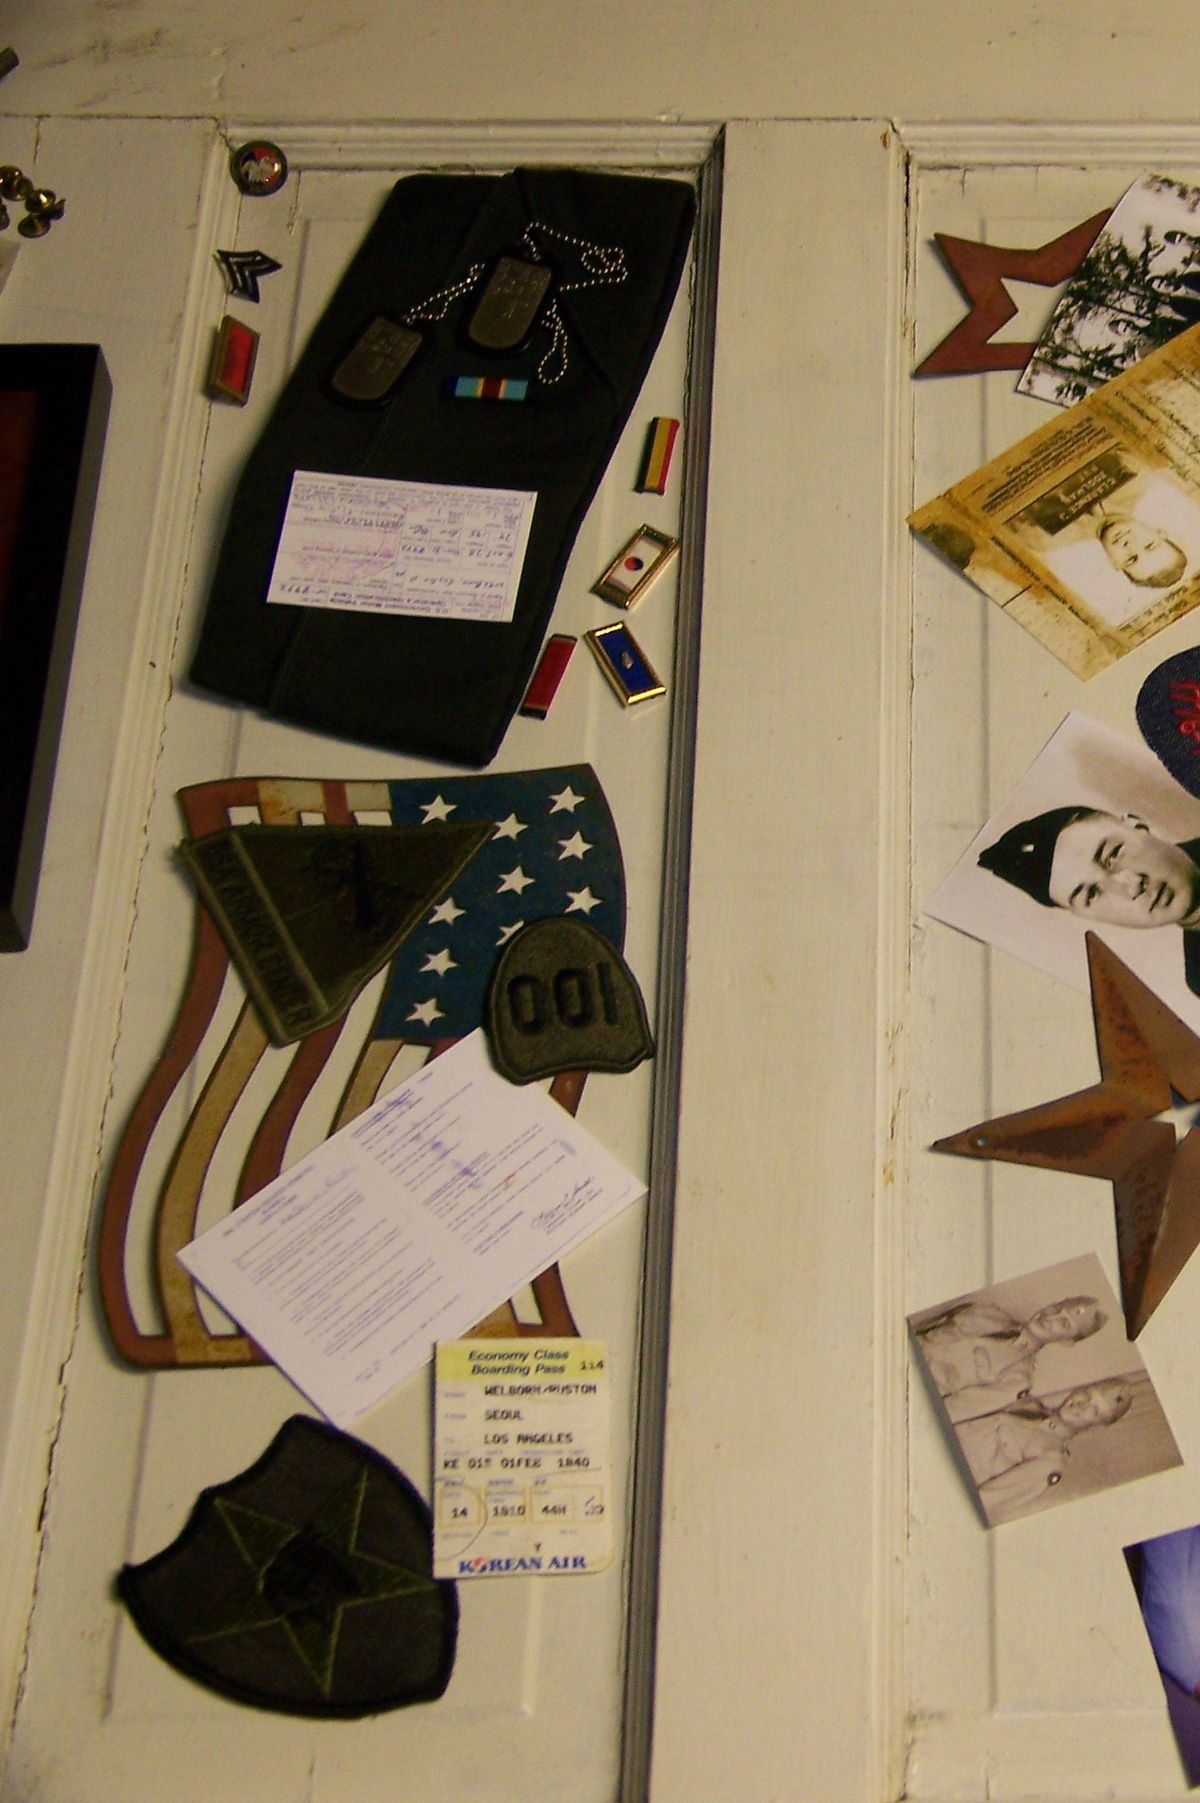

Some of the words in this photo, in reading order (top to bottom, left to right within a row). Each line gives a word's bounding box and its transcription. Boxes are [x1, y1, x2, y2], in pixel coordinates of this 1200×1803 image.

[469, 1350, 529, 1362] Economy
[534, 1349, 569, 1360] Class
[471, 1364, 530, 1376] Boarding
[535, 1364, 566, 1373] Pass
[484, 1410, 523, 1421] SEOUL
[484, 1434, 509, 1445] LOS
[516, 1432, 573, 1445] ANGELES
[443, 1459, 458, 1469] KE
[557, 1458, 591, 1469] 1840
[458, 1557, 542, 1574] KOREAN
[547, 1556, 587, 1570] AIR
